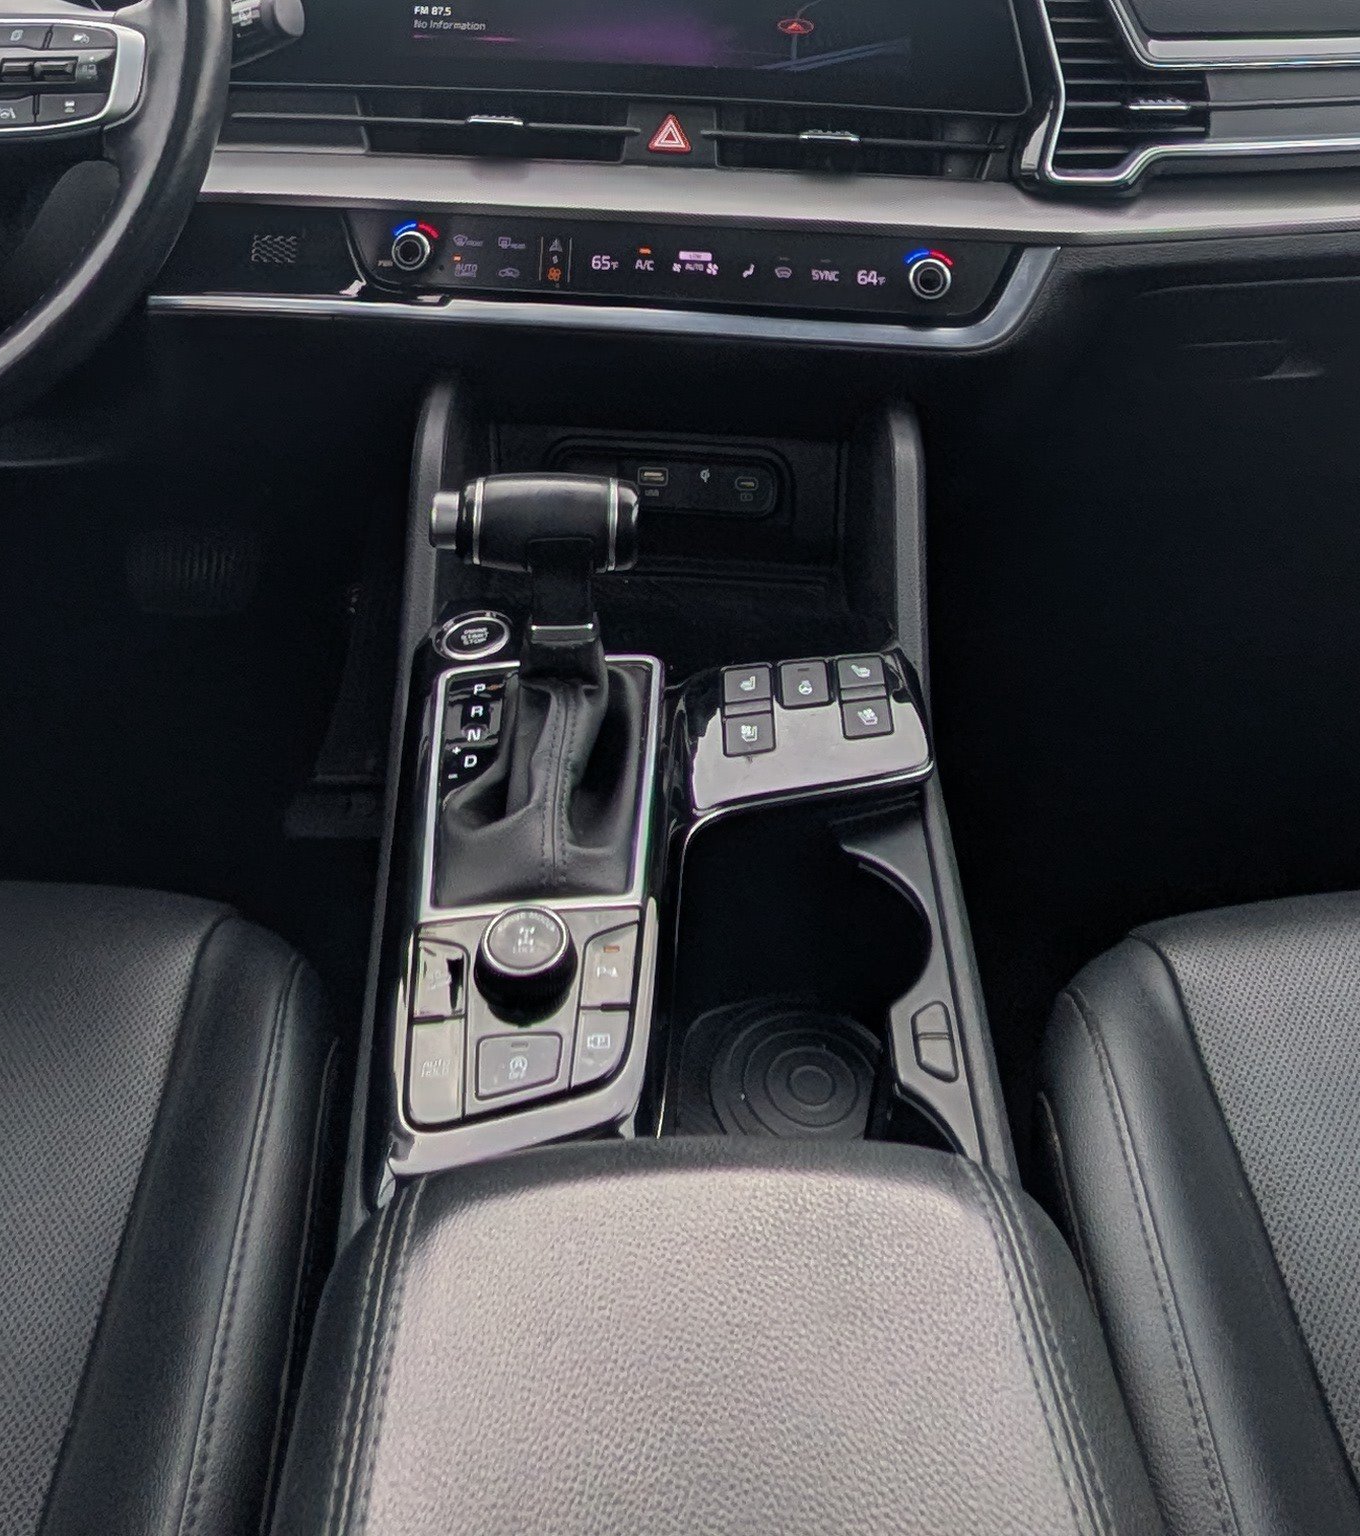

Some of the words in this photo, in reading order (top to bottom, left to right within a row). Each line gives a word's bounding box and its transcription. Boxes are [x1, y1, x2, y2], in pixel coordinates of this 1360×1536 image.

[414, 5, 429, 15] FM
[431, 6, 452, 16] 87.5
[413, 19, 428, 29] No
[429, 19, 486, 31] Information
[455, 264, 478, 272] AUTO
[634, 259, 655, 272] A/C
[811, 268, 840, 282] SYNC
[473, 683, 487, 696] P
[470, 705, 484, 718] R
[467, 728, 481, 742] N
[463, 754, 478, 769] D
